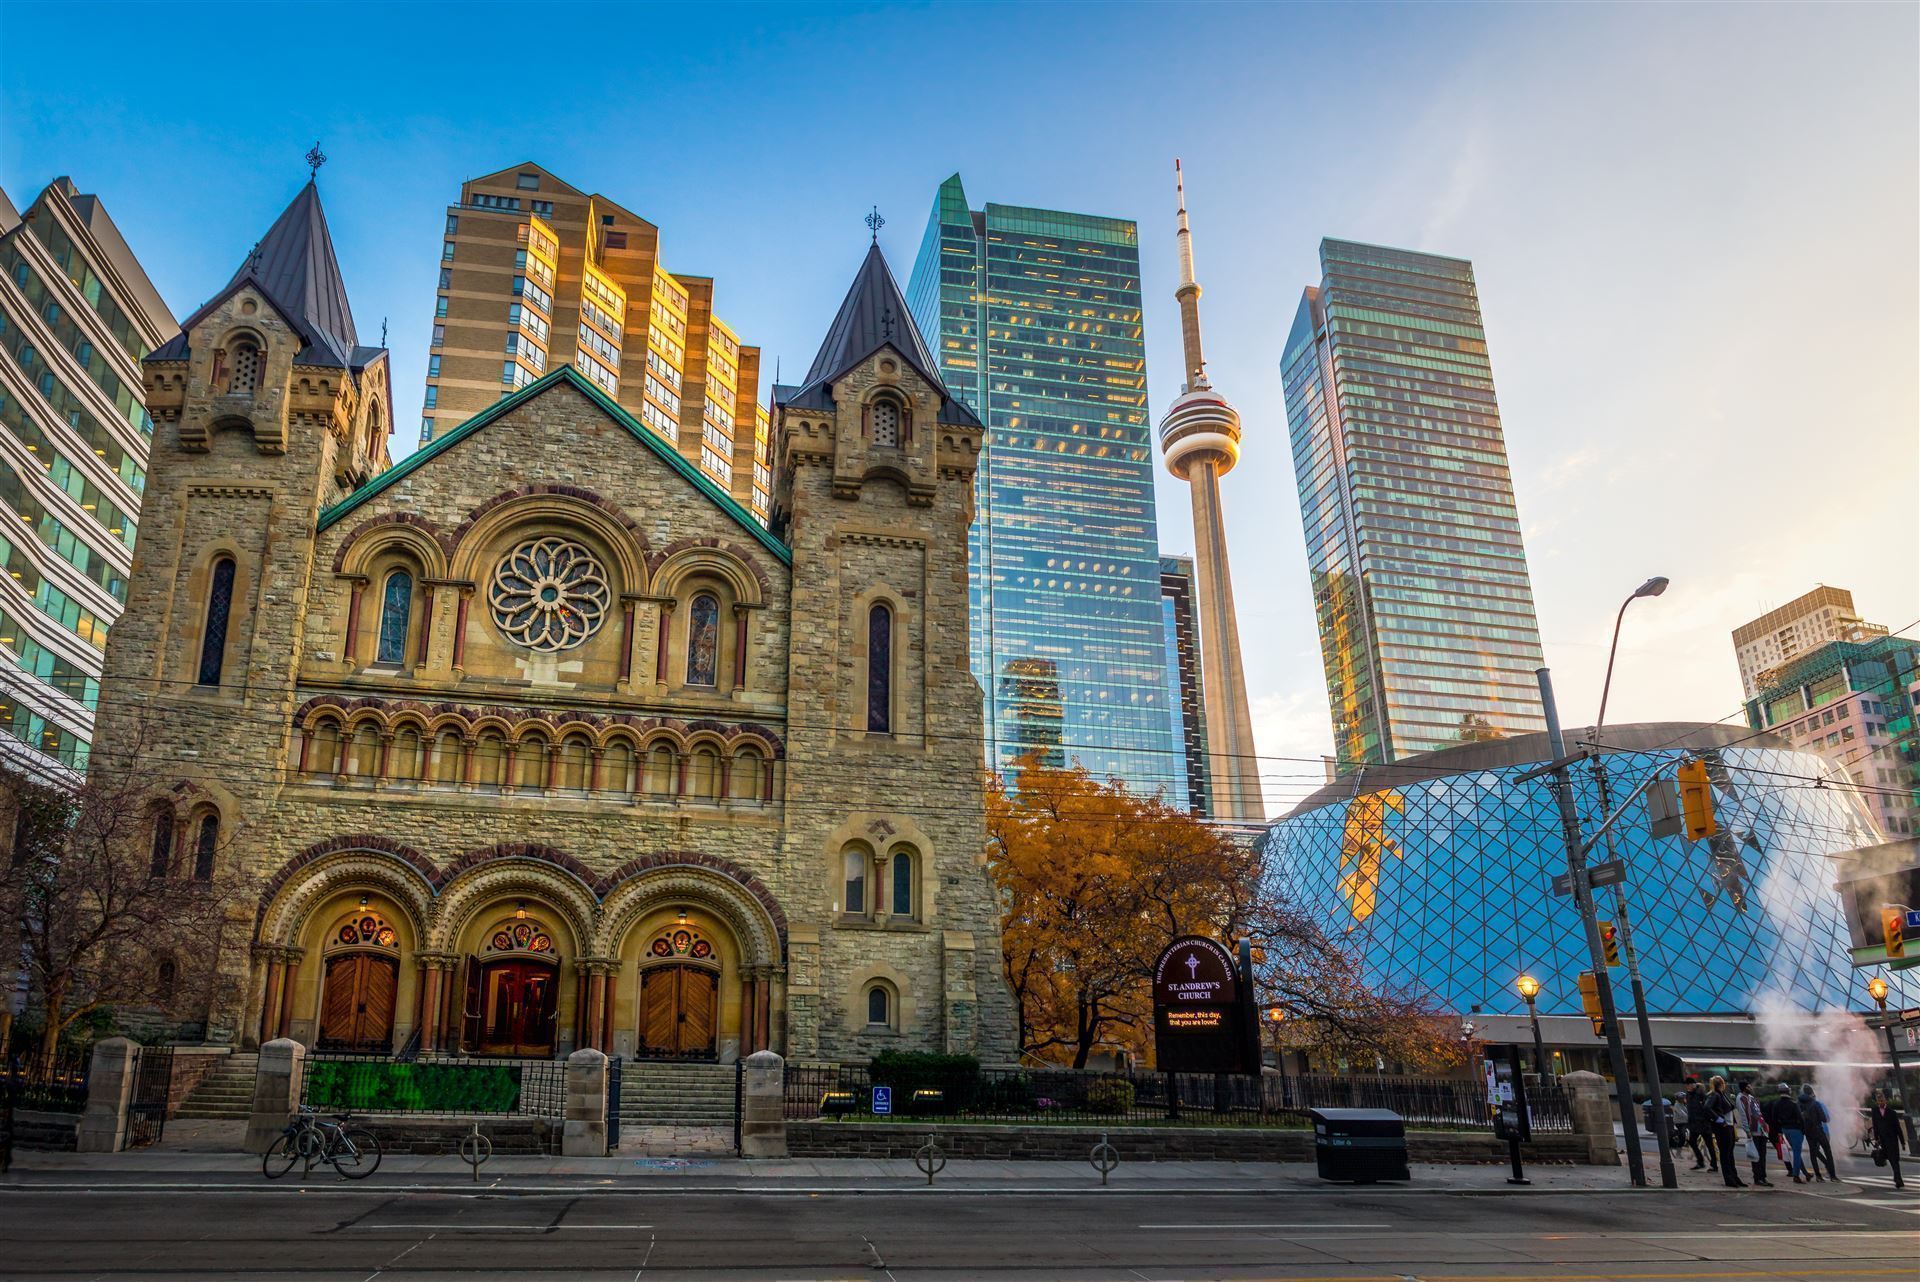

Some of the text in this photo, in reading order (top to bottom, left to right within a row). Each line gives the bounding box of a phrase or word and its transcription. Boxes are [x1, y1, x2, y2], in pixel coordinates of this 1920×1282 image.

[1159, 941, 1190, 971] PRESBYTERIAN
[1190, 940, 1215, 952] CHURCH
[1213, 948, 1220, 956] IN
[1218, 954, 1232, 981] CANADA
[1180, 982, 1220, 991] ANDREW'S
[1178, 992, 1211, 1000] CHURCH
